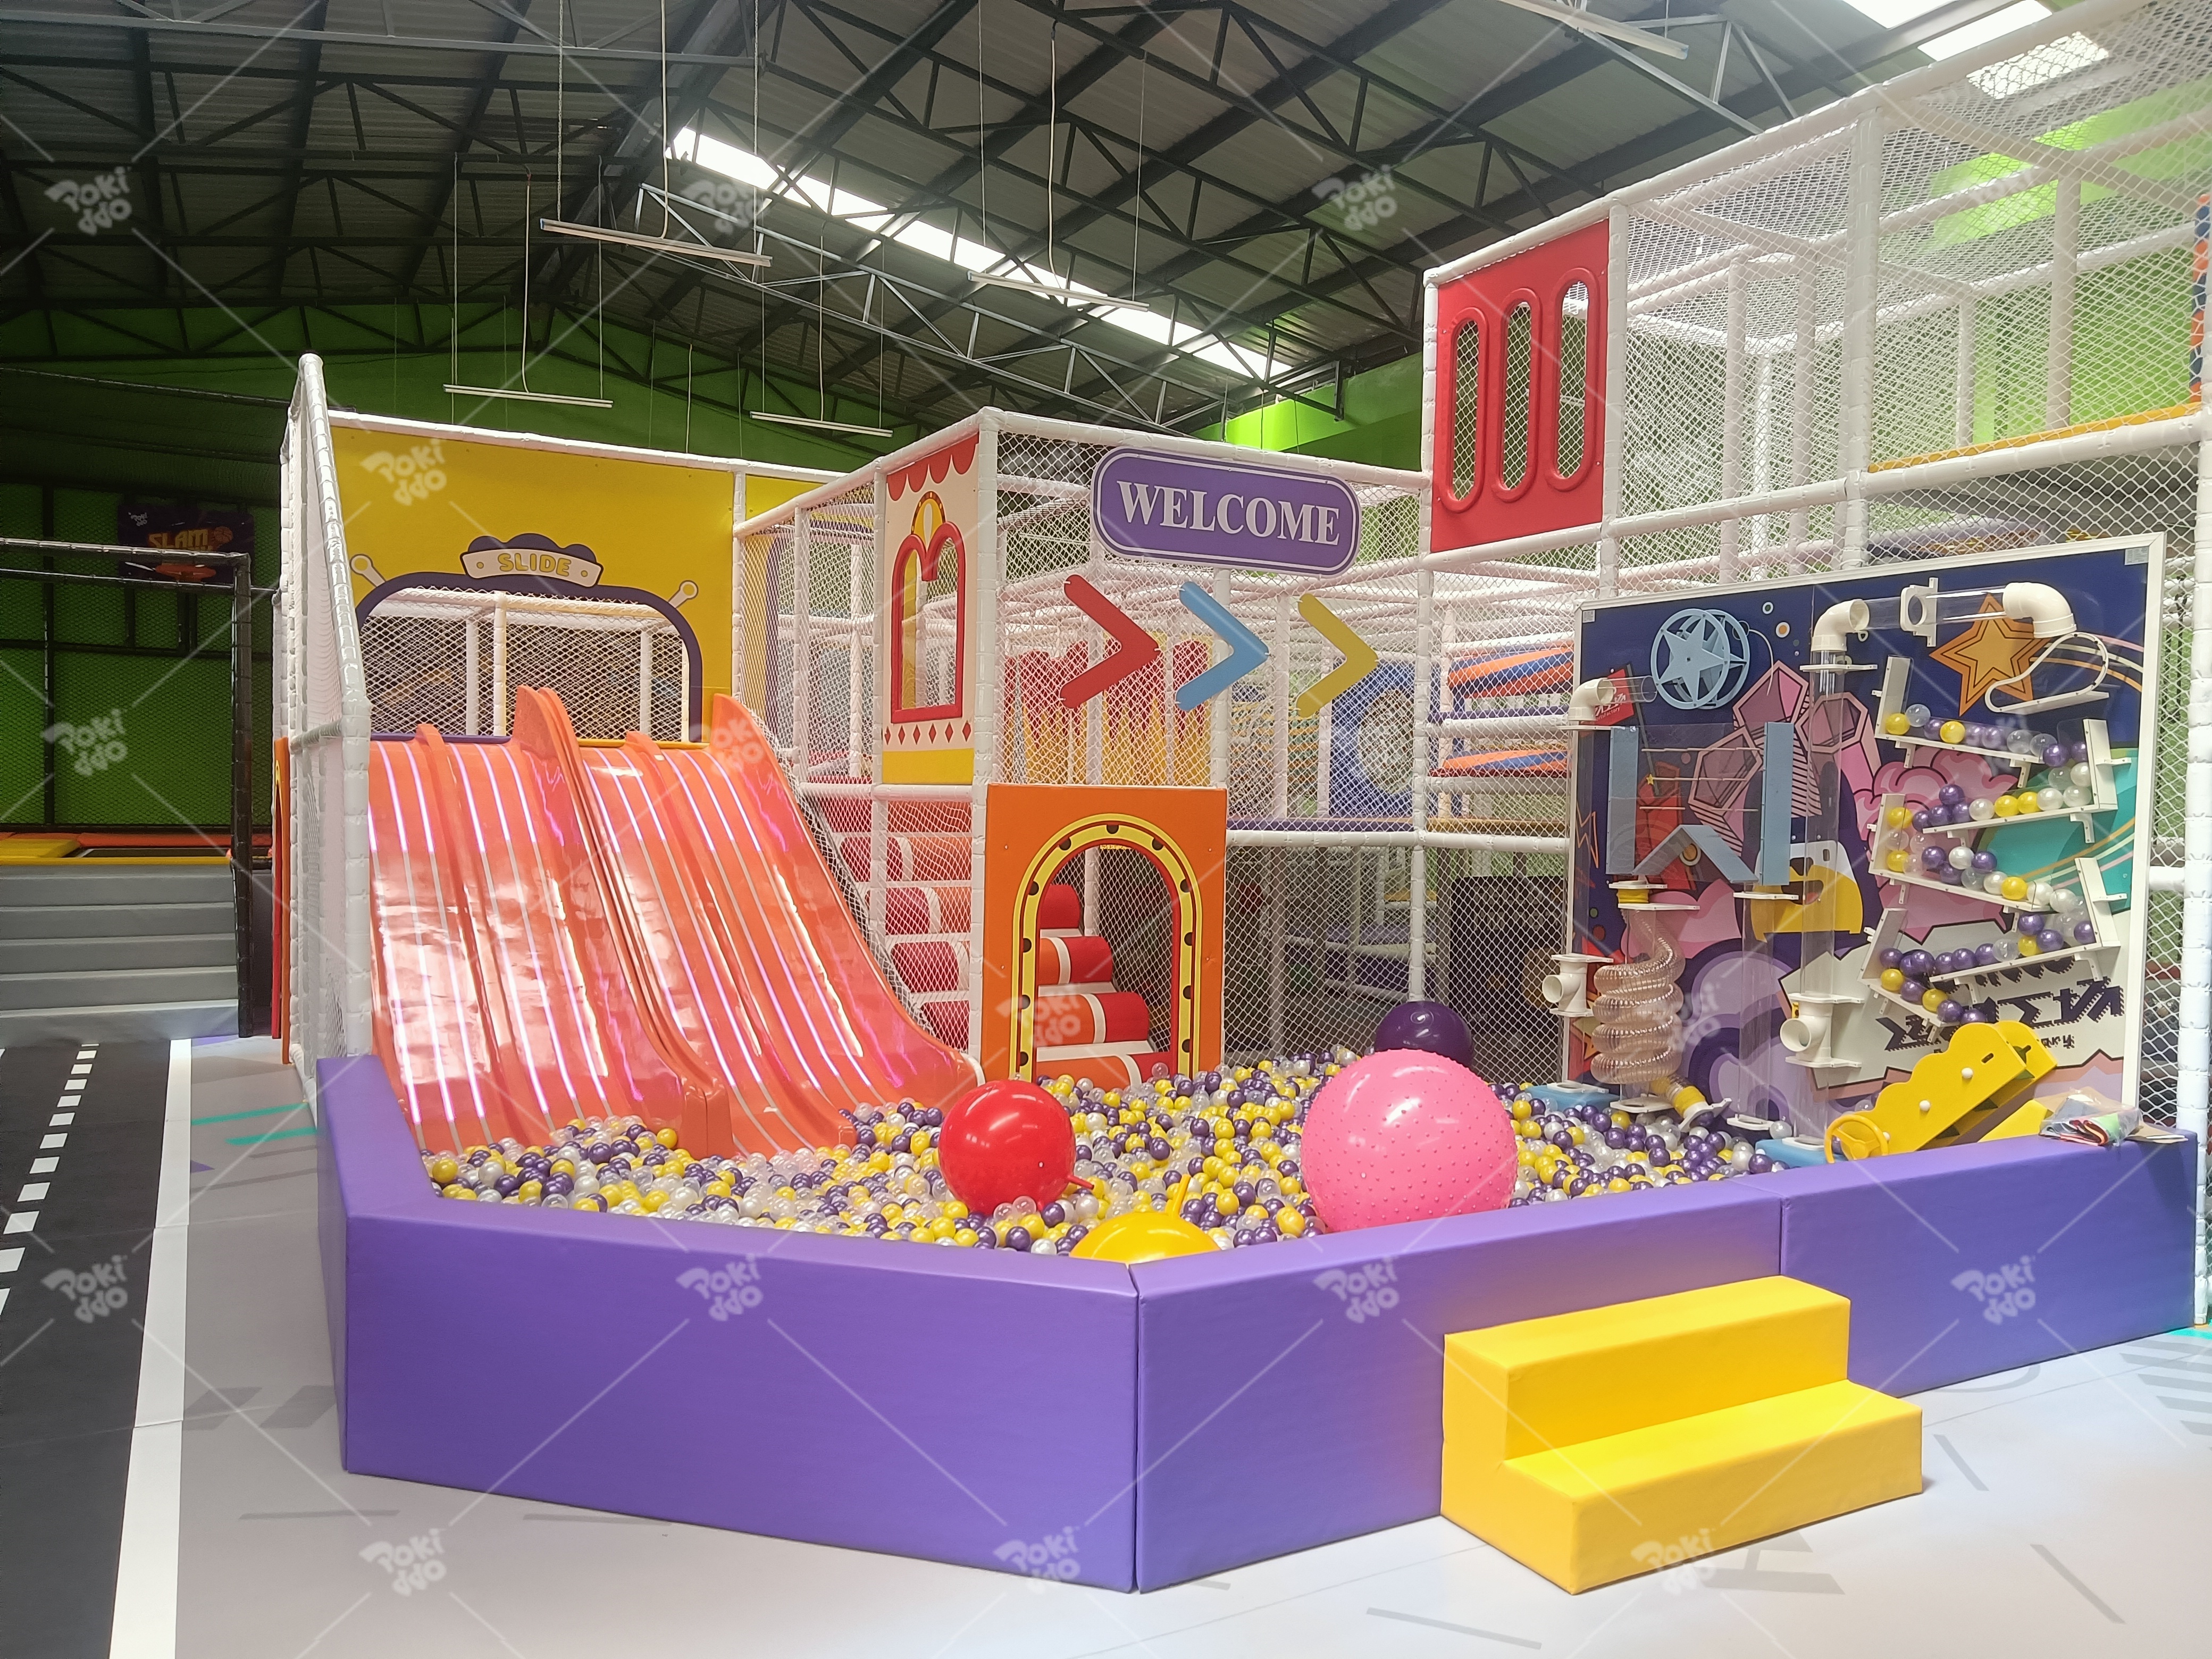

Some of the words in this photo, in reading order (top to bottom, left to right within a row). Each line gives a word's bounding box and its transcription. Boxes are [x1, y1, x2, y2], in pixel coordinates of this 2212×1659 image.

[1116, 480, 1340, 546] WELCOME
[148, 529, 208, 548] SLAM
[497, 552, 572, 577] SLIDE
[1595, 707, 1620, 722] ortsFactory
